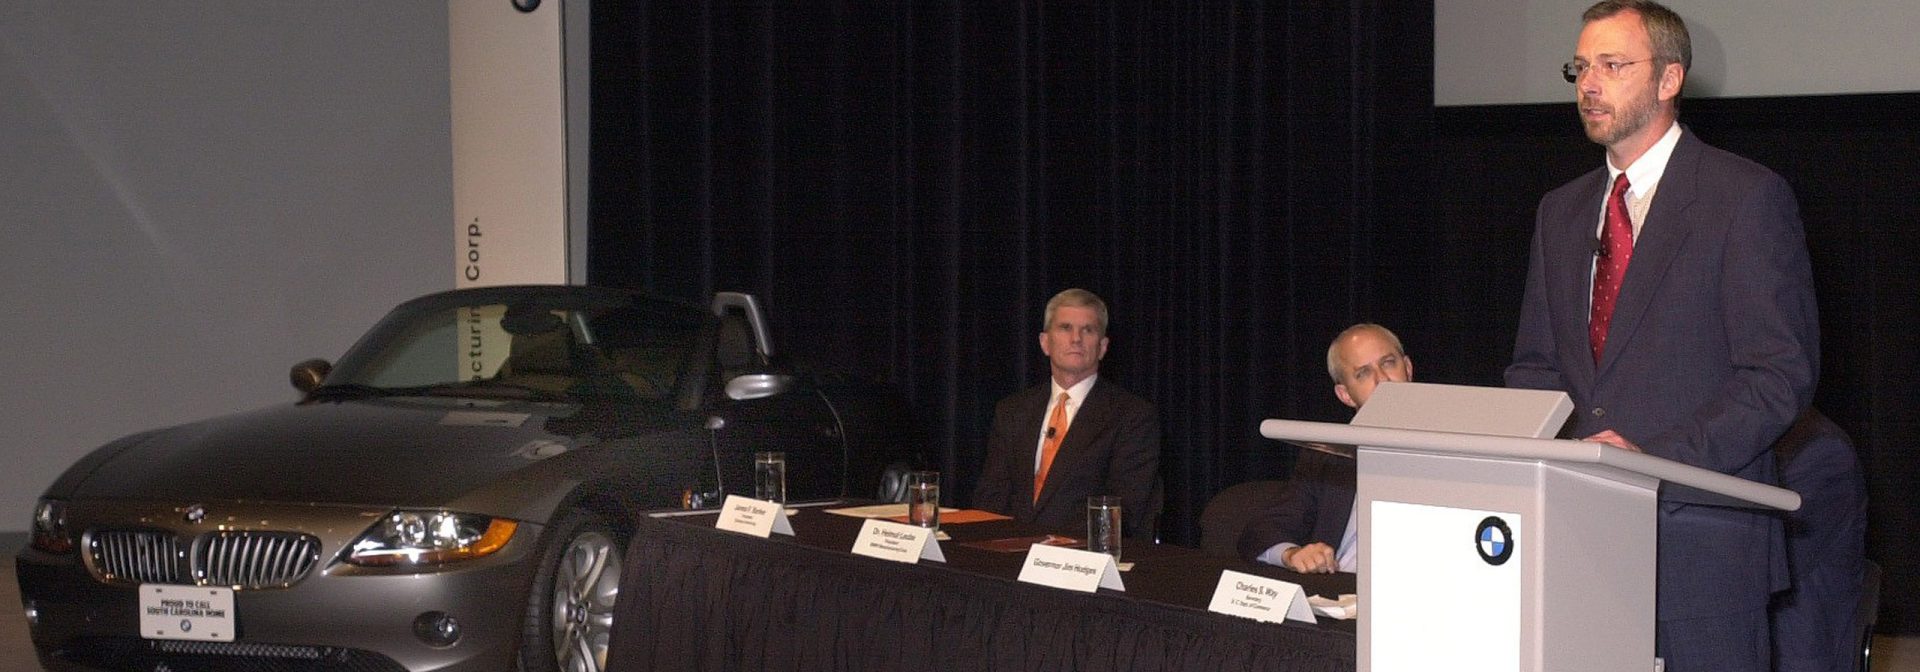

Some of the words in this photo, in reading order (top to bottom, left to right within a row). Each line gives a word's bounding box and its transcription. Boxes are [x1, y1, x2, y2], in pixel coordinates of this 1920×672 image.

[465, 217, 482, 282] Corp.
[1033, 558, 1062, 570] Governor
[1062, 562, 1073, 571] Jim
[1236, 581, 1258, 594] Charles
[1265, 587, 1279, 600] Way
[161, 599, 184, 608] PROUD
[185, 600, 194, 608] TO
[195, 600, 210, 609] CALL
[147, 606, 168, 615] SOUTH
[170, 607, 203, 617] CAROLINA
